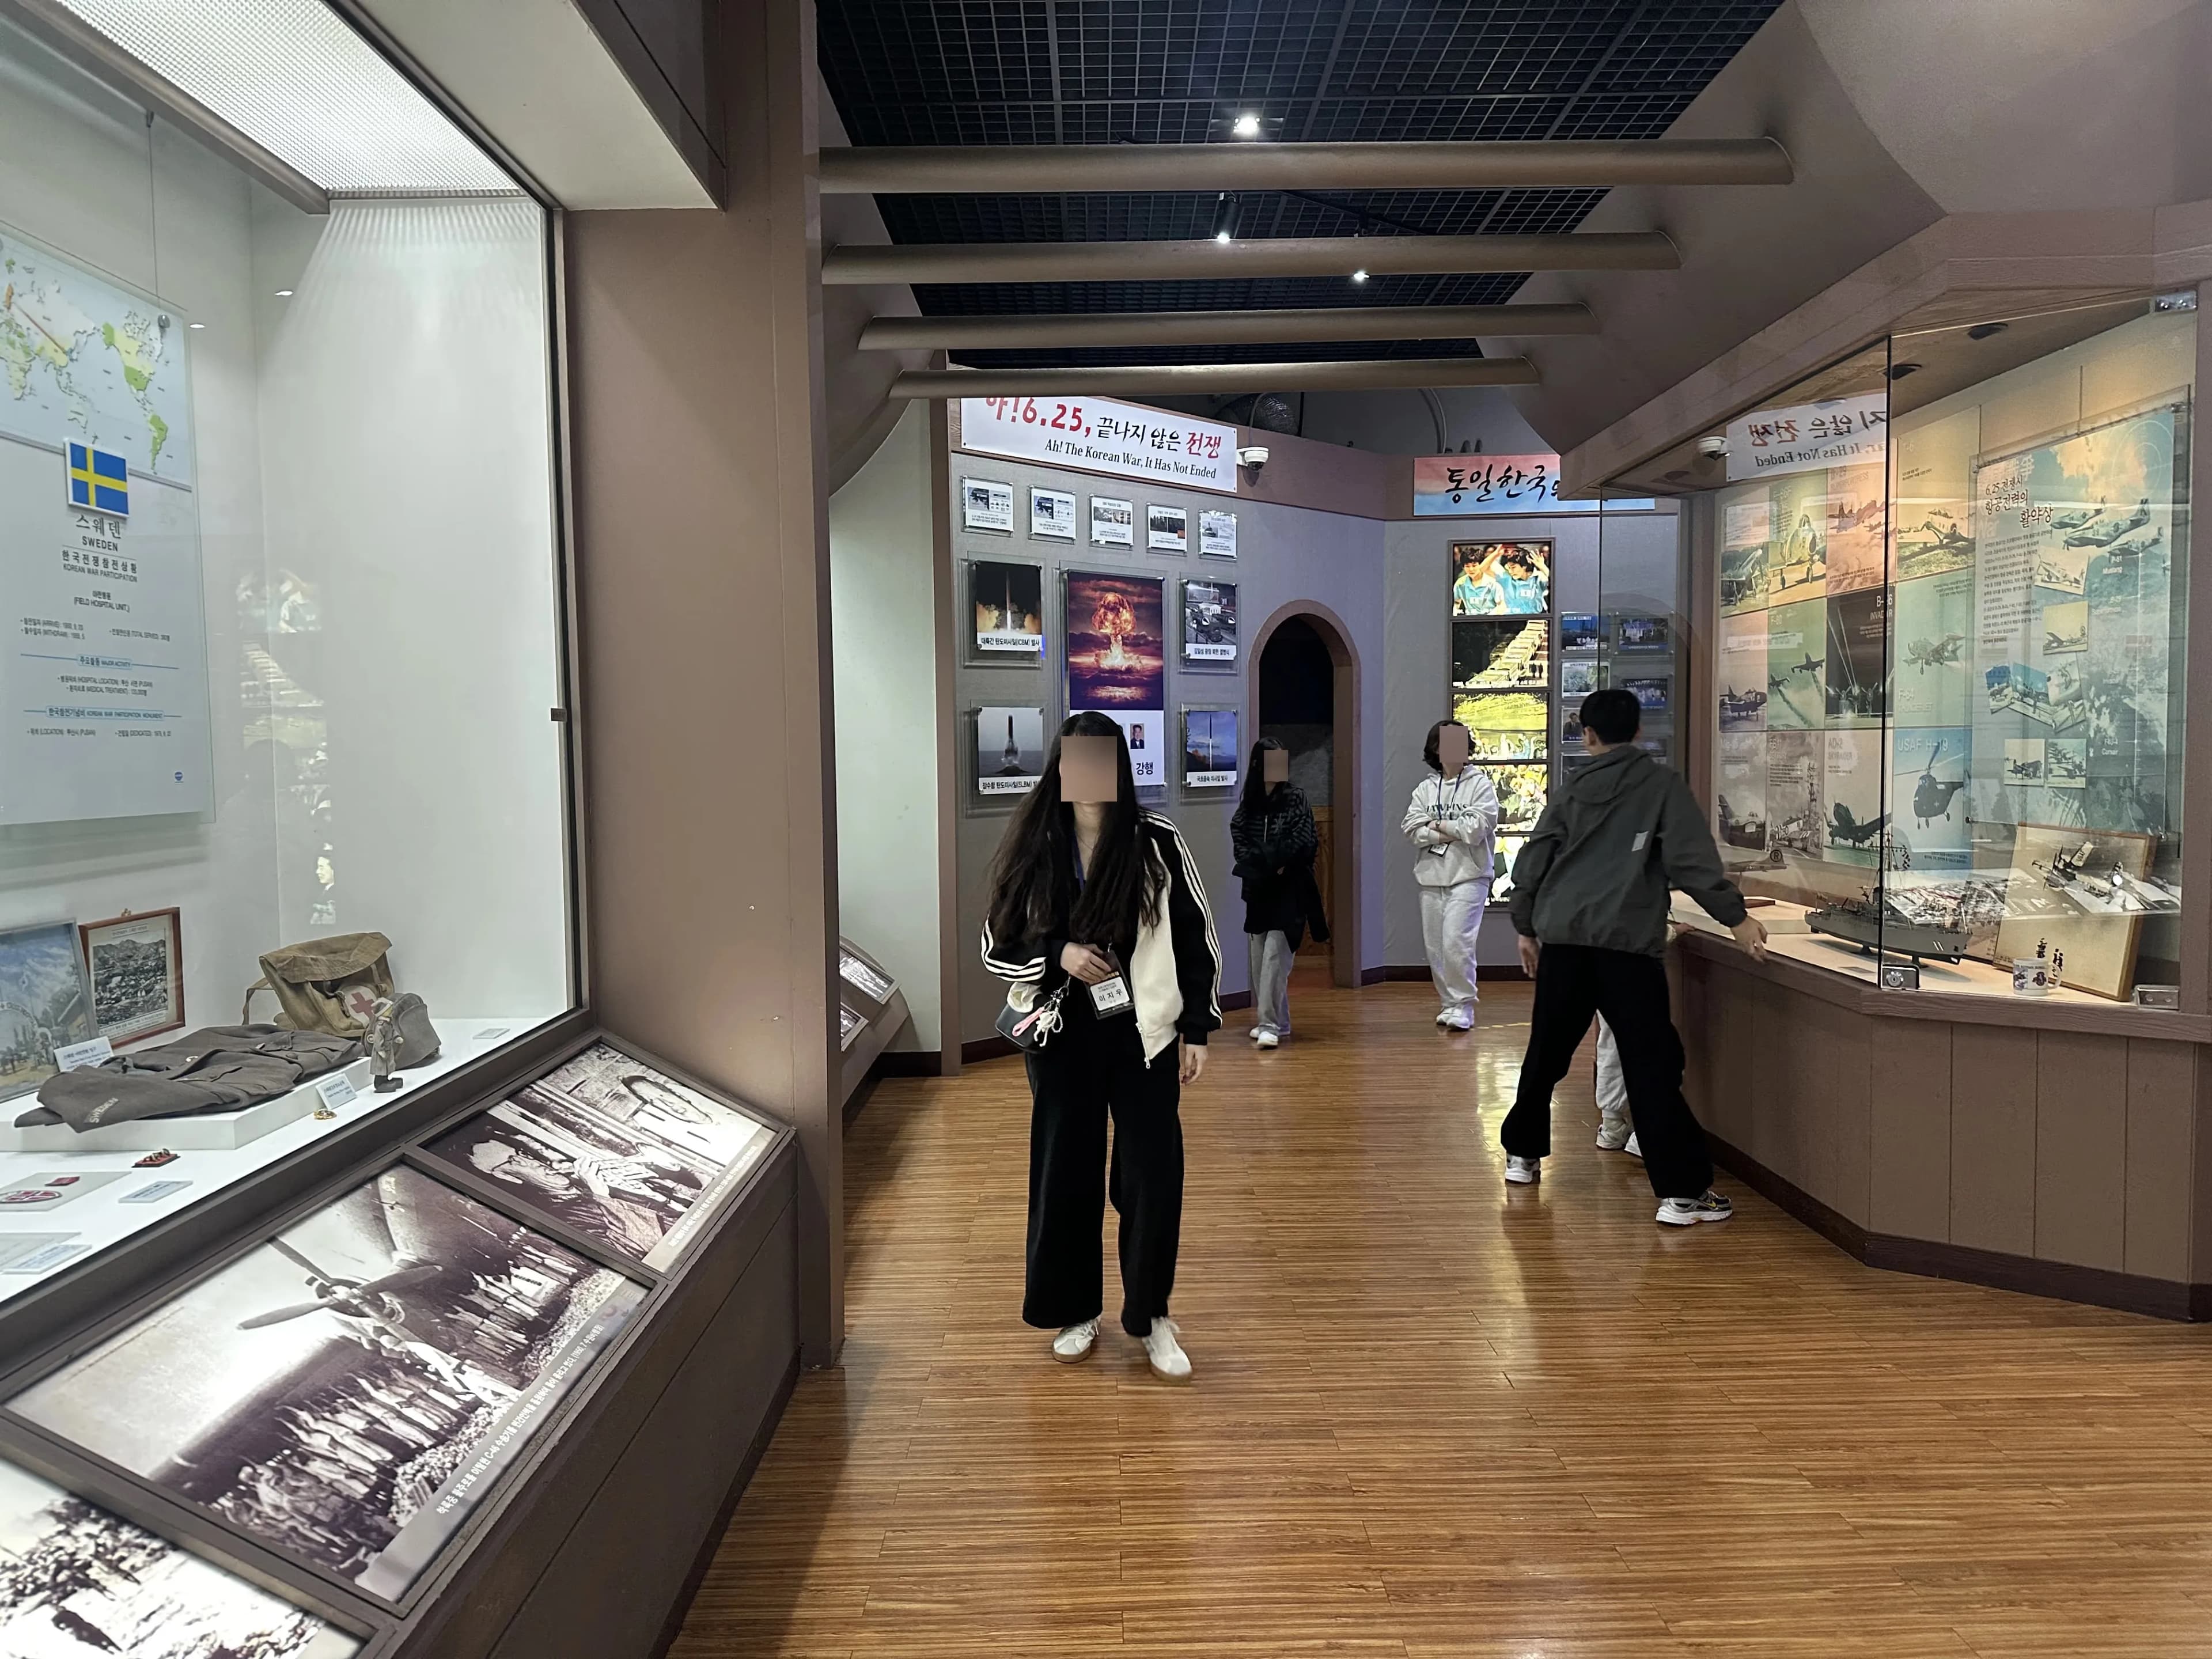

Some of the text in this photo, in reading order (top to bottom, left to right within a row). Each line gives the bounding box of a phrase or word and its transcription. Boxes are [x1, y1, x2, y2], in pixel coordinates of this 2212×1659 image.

[1097, 417, 1146, 446] 끝나지
[1150, 428, 1181, 452] 않은
[1185, 432, 1222, 459] 전쟁
[1045, 438, 1217, 479] Ah! The Korean War, It Has Not Ended
[2002, 474, 2023, 493] 전쟁시
[1985, 488, 2028, 516] 항공전력의
[2020, 506, 2054, 529] 활약상
[75, 514, 122, 539] 스웨덴
[82, 536, 119, 552] SWEDEN
[63, 563, 138, 583] KOREAN WAR PARTICIPATION
[90, 599, 115, 610] HOSPITAL
[1876, 594, 1893, 608] B-6
[981, 637, 994, 645] 대륙간
[1897, 737, 1922, 752] USAF
[1135, 762, 1154, 775] 강행
[982, 781, 995, 790] 잠수함
[1099, 988, 1123, 1002] 이지우
